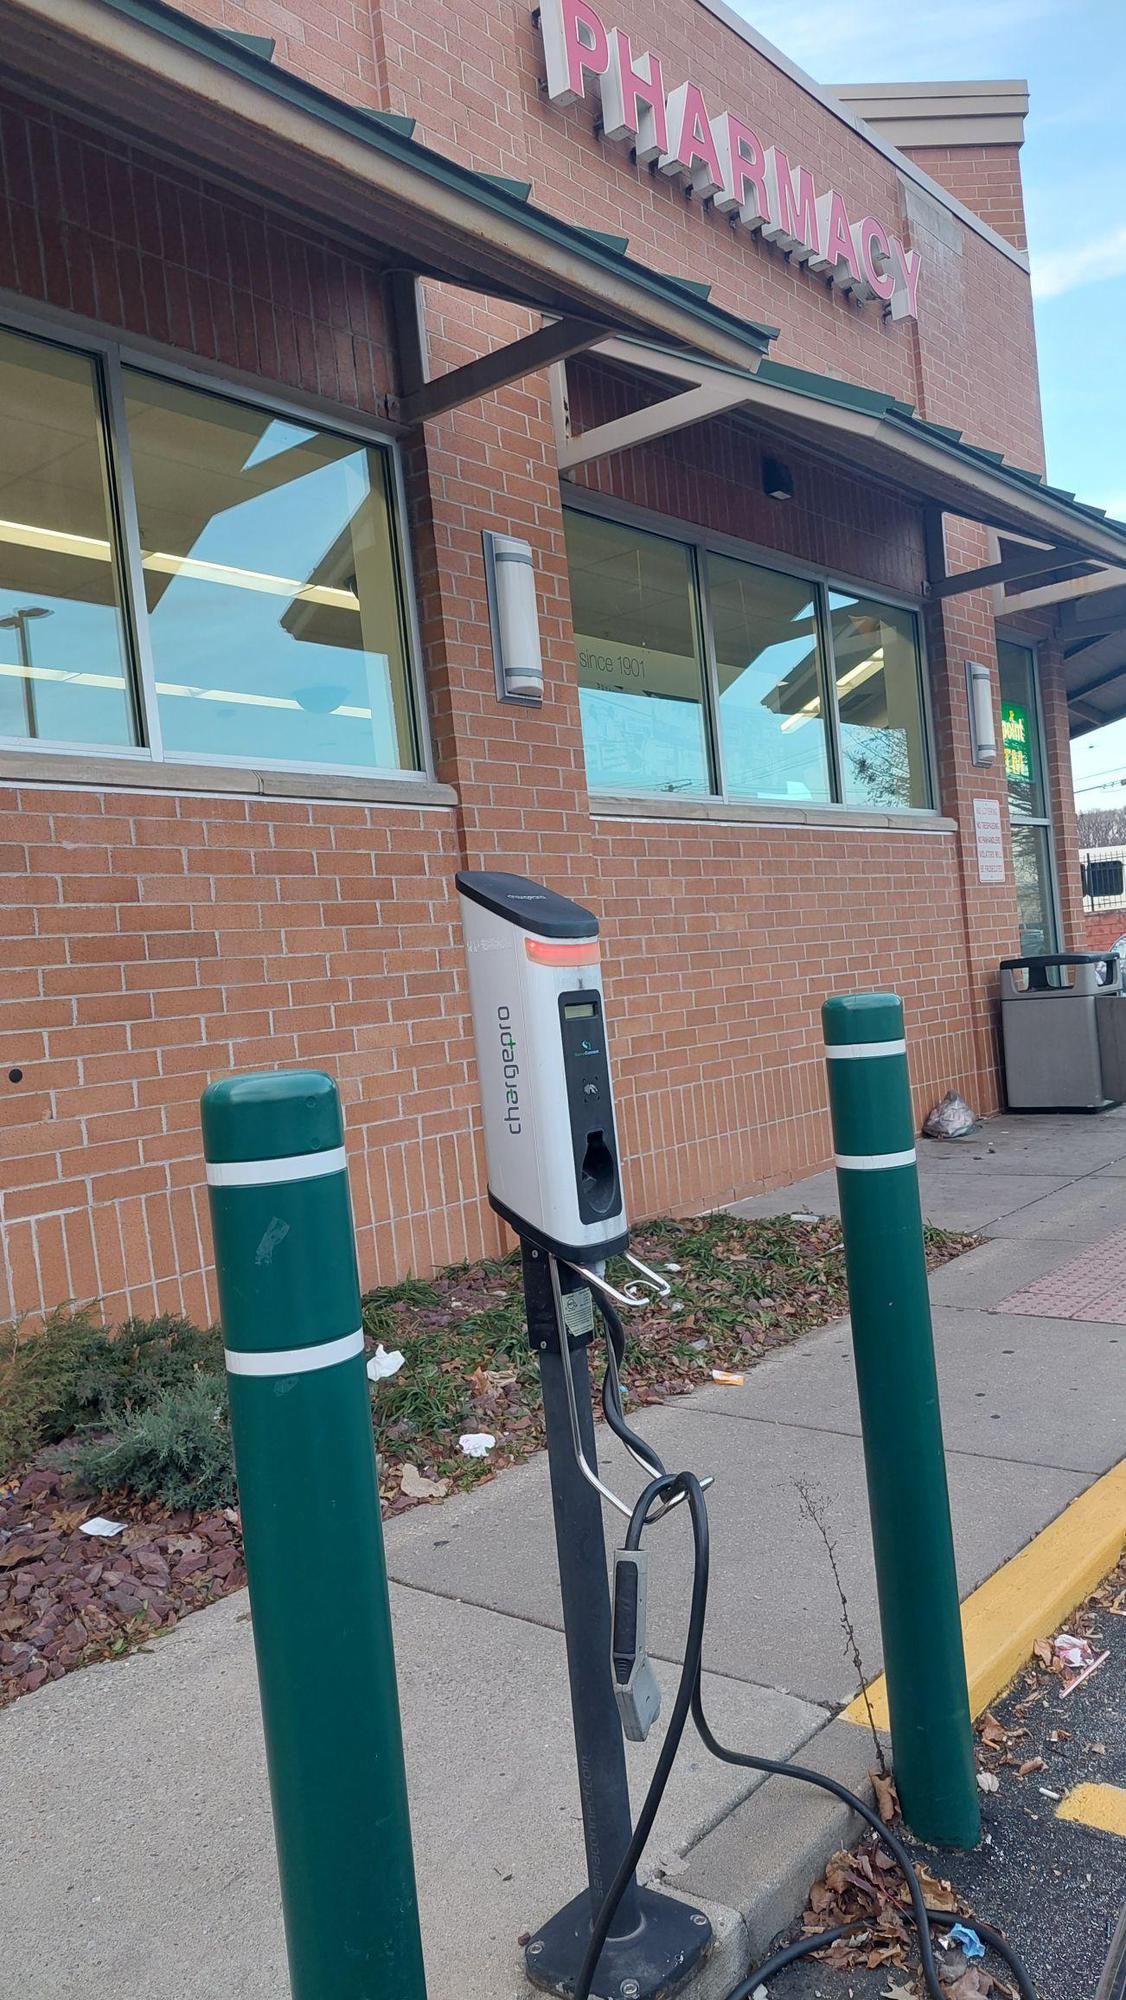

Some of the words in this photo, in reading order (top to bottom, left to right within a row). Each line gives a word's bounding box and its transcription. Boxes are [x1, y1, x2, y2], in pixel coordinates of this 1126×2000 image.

[542, 0, 921, 321] PHARMACY
[579, 649, 614, 672] since
[617, 656, 645, 680] 1901
[497, 1005, 521, 1134] chargepro
